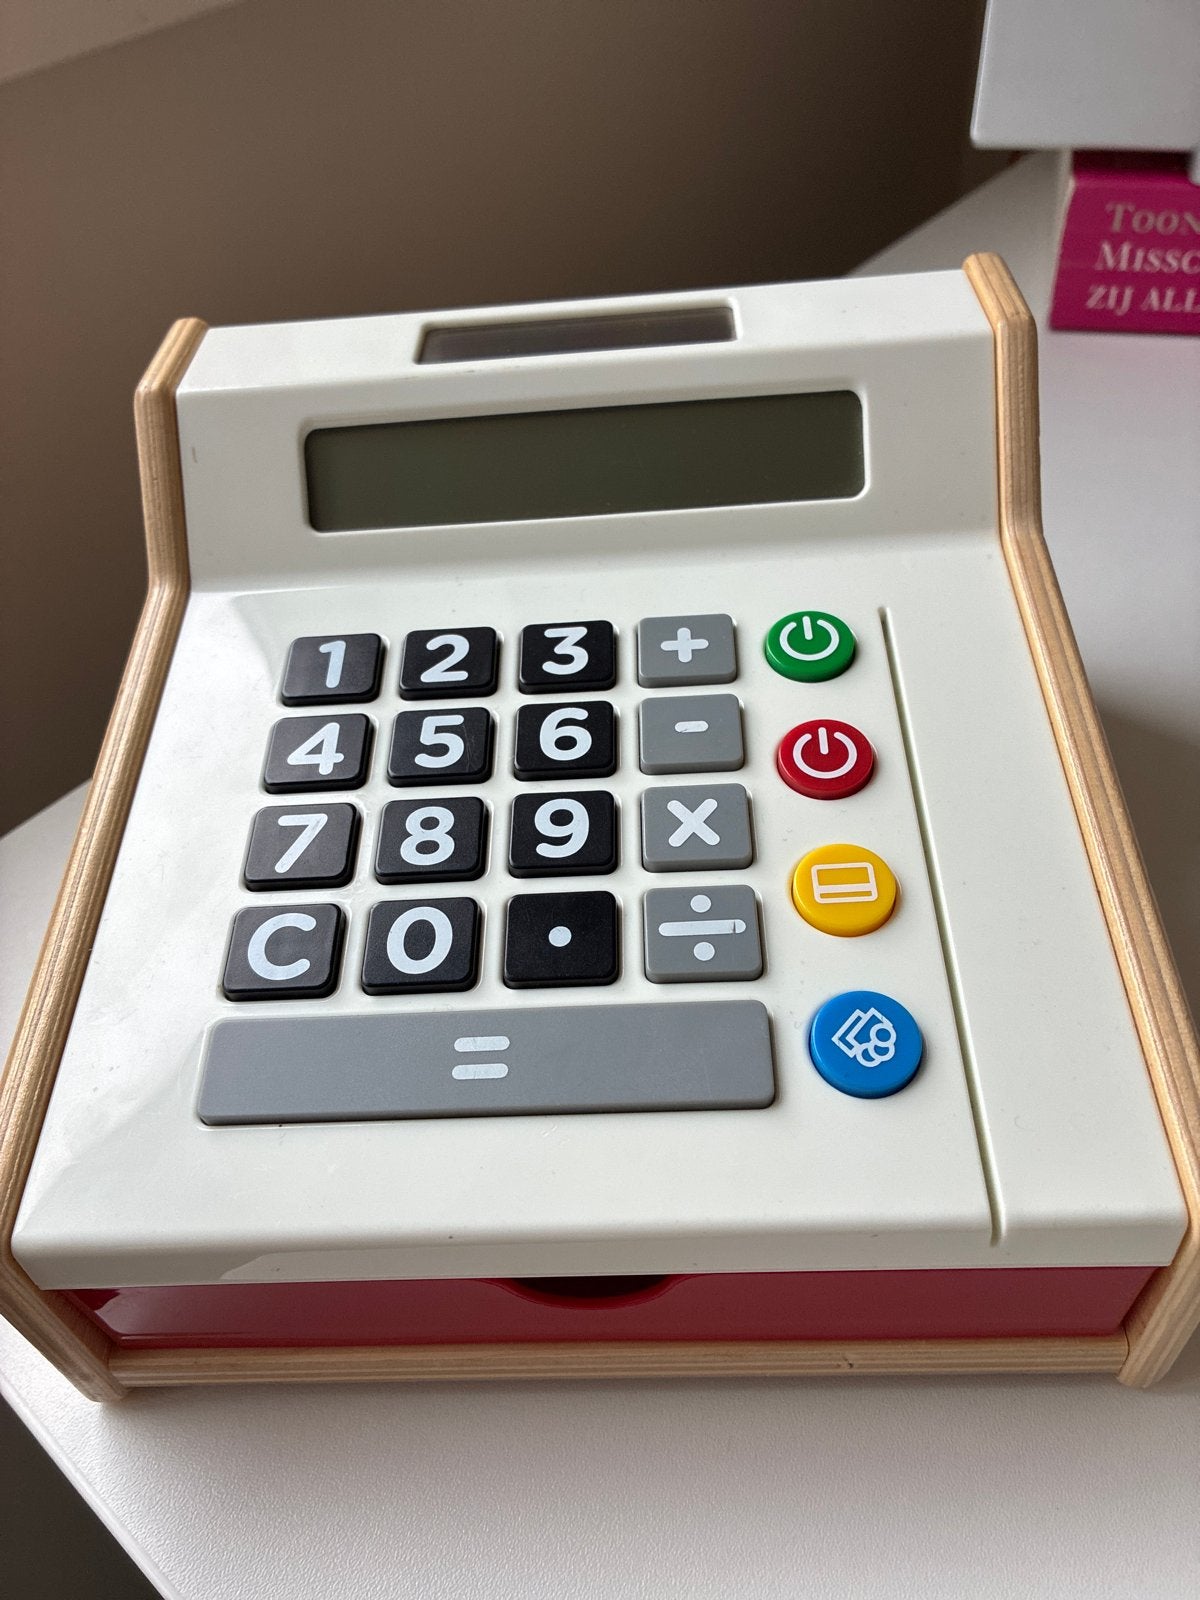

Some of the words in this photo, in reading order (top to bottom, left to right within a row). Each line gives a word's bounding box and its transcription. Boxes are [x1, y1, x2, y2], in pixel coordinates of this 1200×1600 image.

[1086, 285, 1134, 316] ZIJ
[319, 640, 346, 688] 1
[420, 635, 470, 682] 2
[541, 627, 589, 675] 3
[286, 722, 344, 775] 4
[415, 715, 464, 768] 5
[539, 707, 592, 760] 6
[275, 814, 328, 873] 7
[400, 806, 454, 865] 8
[535, 799, 589, 858] 9
[247, 912, 316, 980] C
[387, 907, 452, 974] 0
